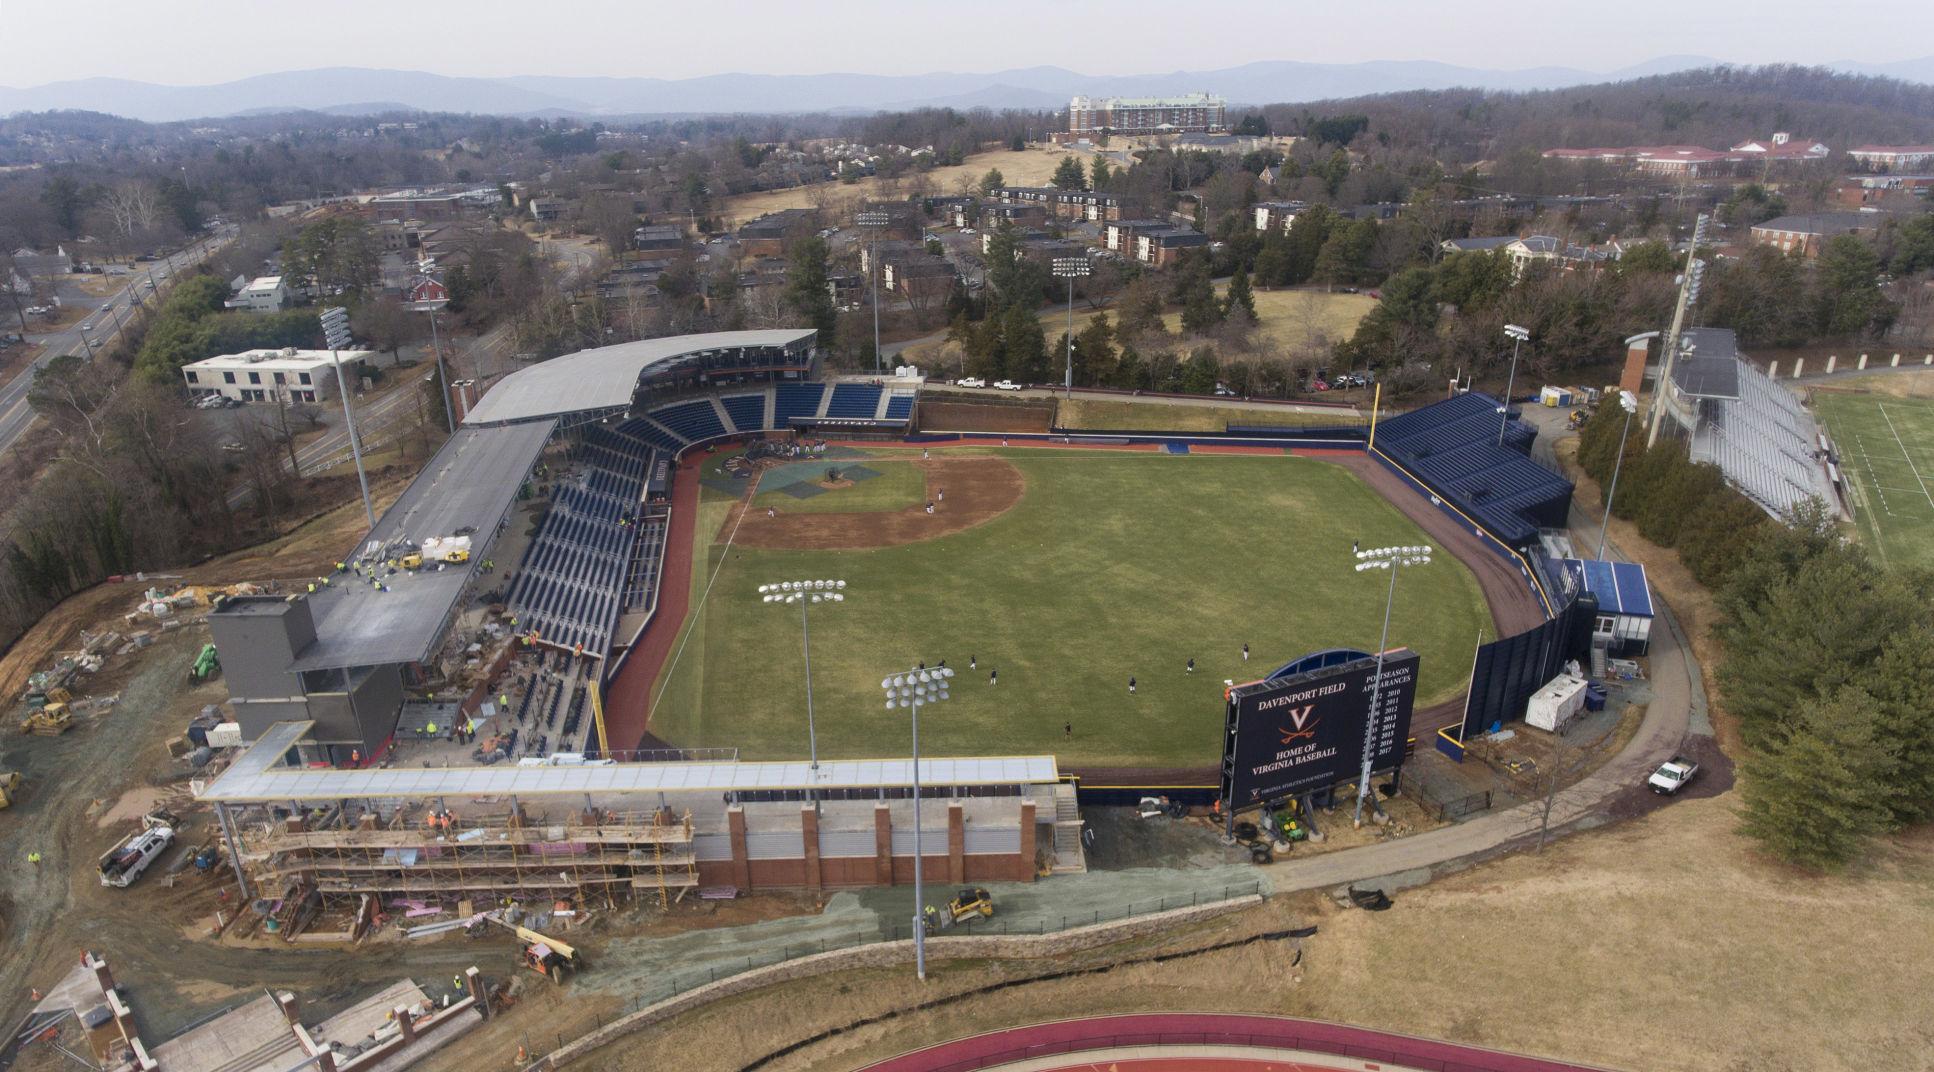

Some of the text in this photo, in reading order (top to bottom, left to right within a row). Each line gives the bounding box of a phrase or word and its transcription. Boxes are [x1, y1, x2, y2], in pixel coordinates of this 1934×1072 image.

[1366, 666, 1410, 682] POTSEASON
[1362, 674, 1411, 692] APPARANCES
[1258, 682, 1346, 710] DAVENPORT FIELD
[1387, 689, 1400, 697] 2010
[1386, 697, 1399, 706] 2011
[1385, 706, 1398, 714] 2012
[1384, 714, 1396, 722] 2013
[1382, 722, 1395, 731] 2014
[1381, 730, 1394, 739] 2015
[1380, 739, 1393, 747] 2016
[1276, 743, 1317, 760] HOME OF
[1379, 746, 1392, 755] 2017
[1252, 747, 1337, 775] VIRGINIA BASEBALL
